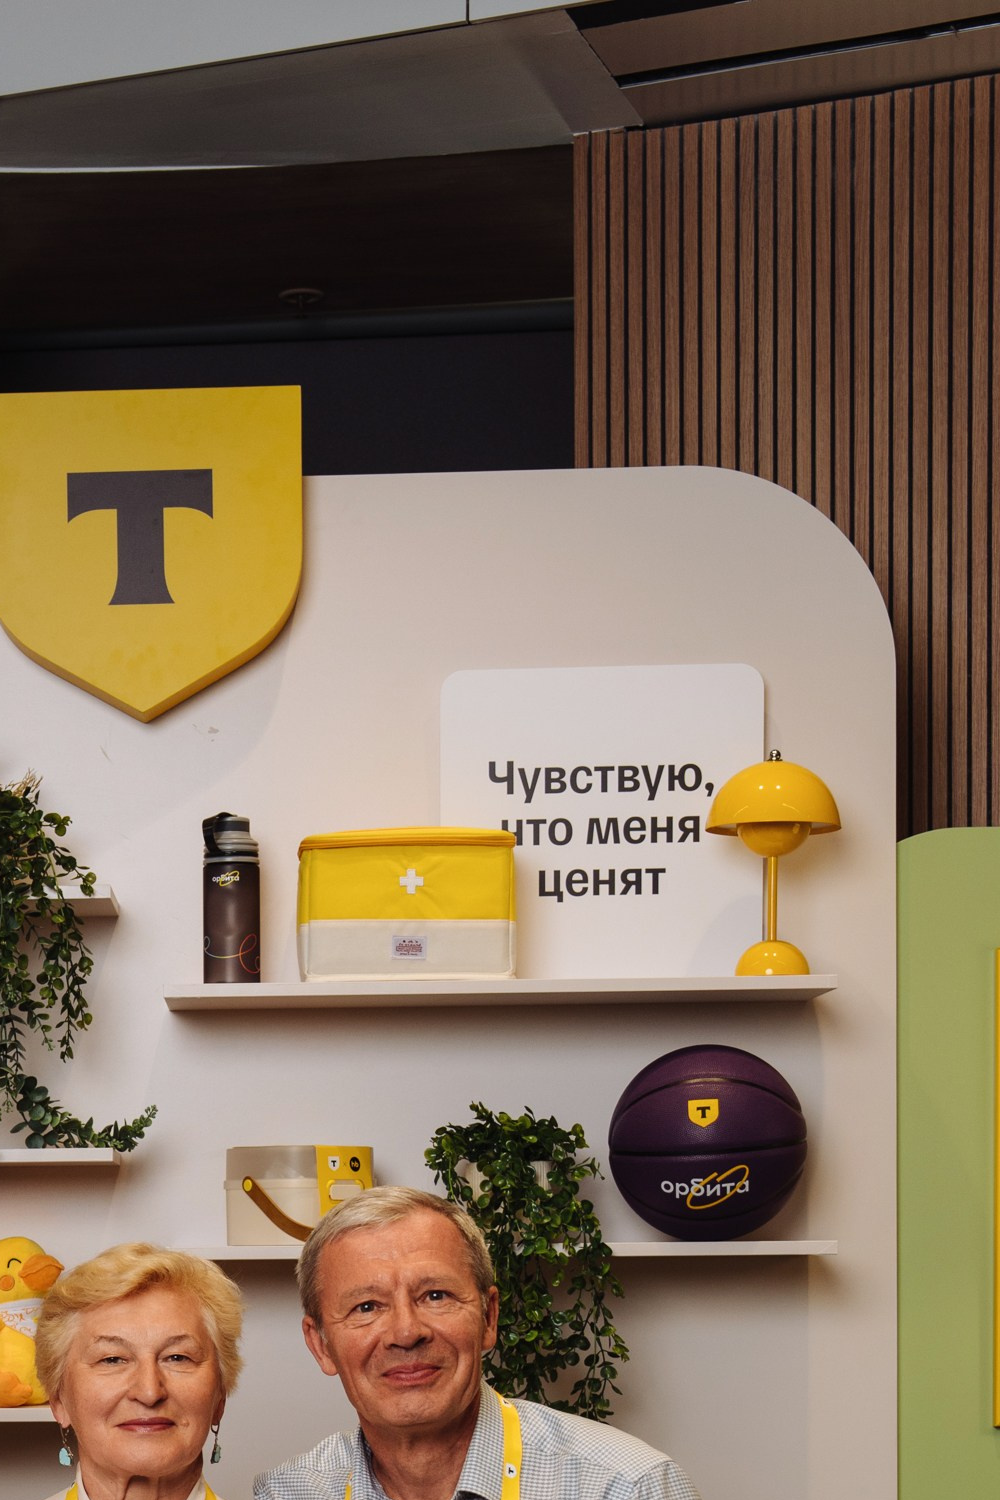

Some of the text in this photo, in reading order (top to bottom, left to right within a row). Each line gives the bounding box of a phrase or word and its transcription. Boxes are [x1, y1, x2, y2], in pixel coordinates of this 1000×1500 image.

[67, 468, 213, 605] Т
[488, 761, 714, 804] Чувствую,
[501, 815, 700, 846] что меня
[538, 868, 666, 903] ценят
[660, 1177, 750, 1199] орбита
